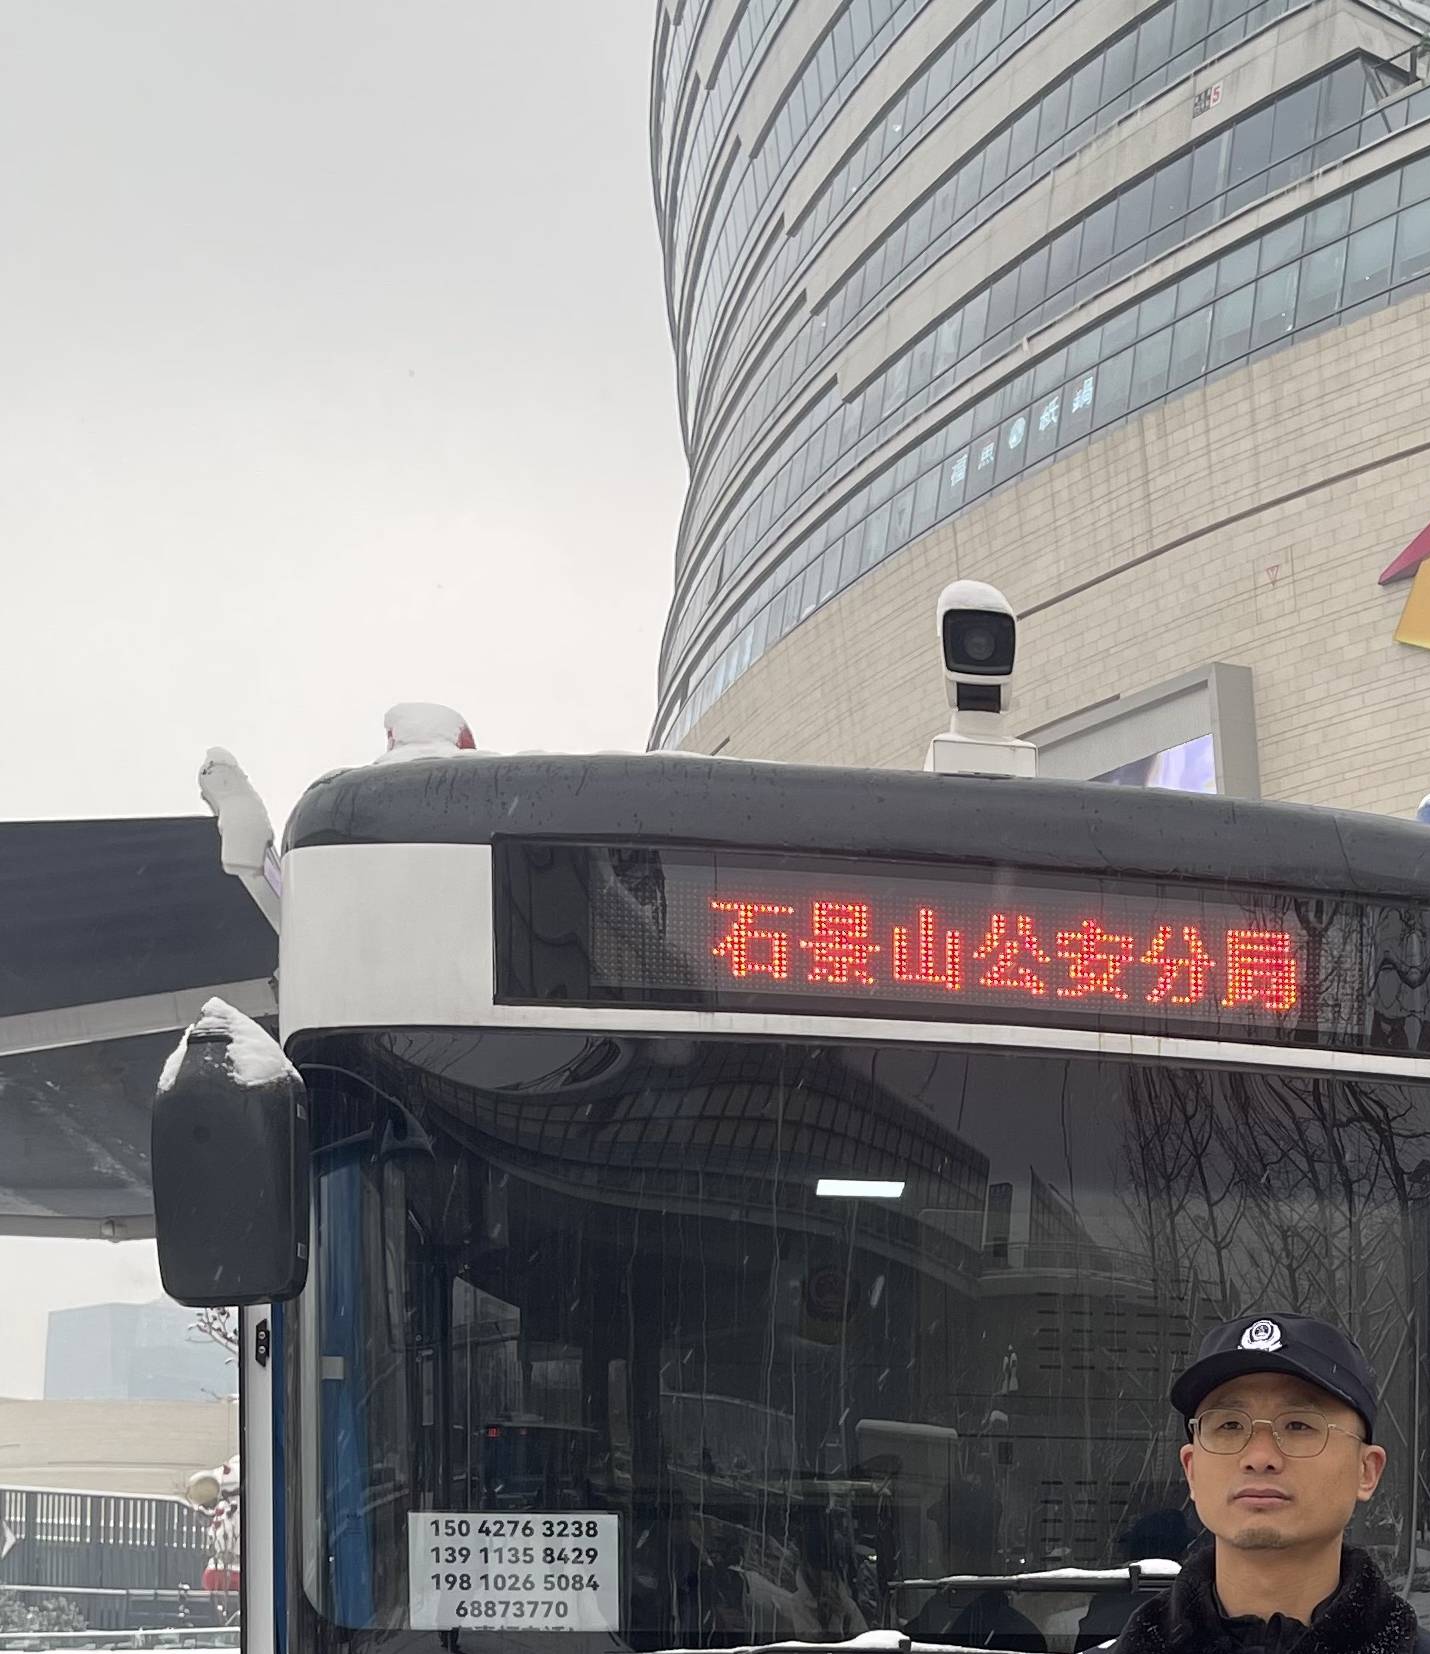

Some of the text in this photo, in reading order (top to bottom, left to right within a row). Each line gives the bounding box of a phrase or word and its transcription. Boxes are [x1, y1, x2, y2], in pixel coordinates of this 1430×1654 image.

[710, 899, 1298, 1011] 石景山公安分局
[430, 1519, 599, 1538] 150 4276 3238
[430, 1546, 599, 1565] 139 1135 8429
[431, 1573, 600, 1592] 198 1026 5084
[455, 1600, 569, 1618] 68873770
